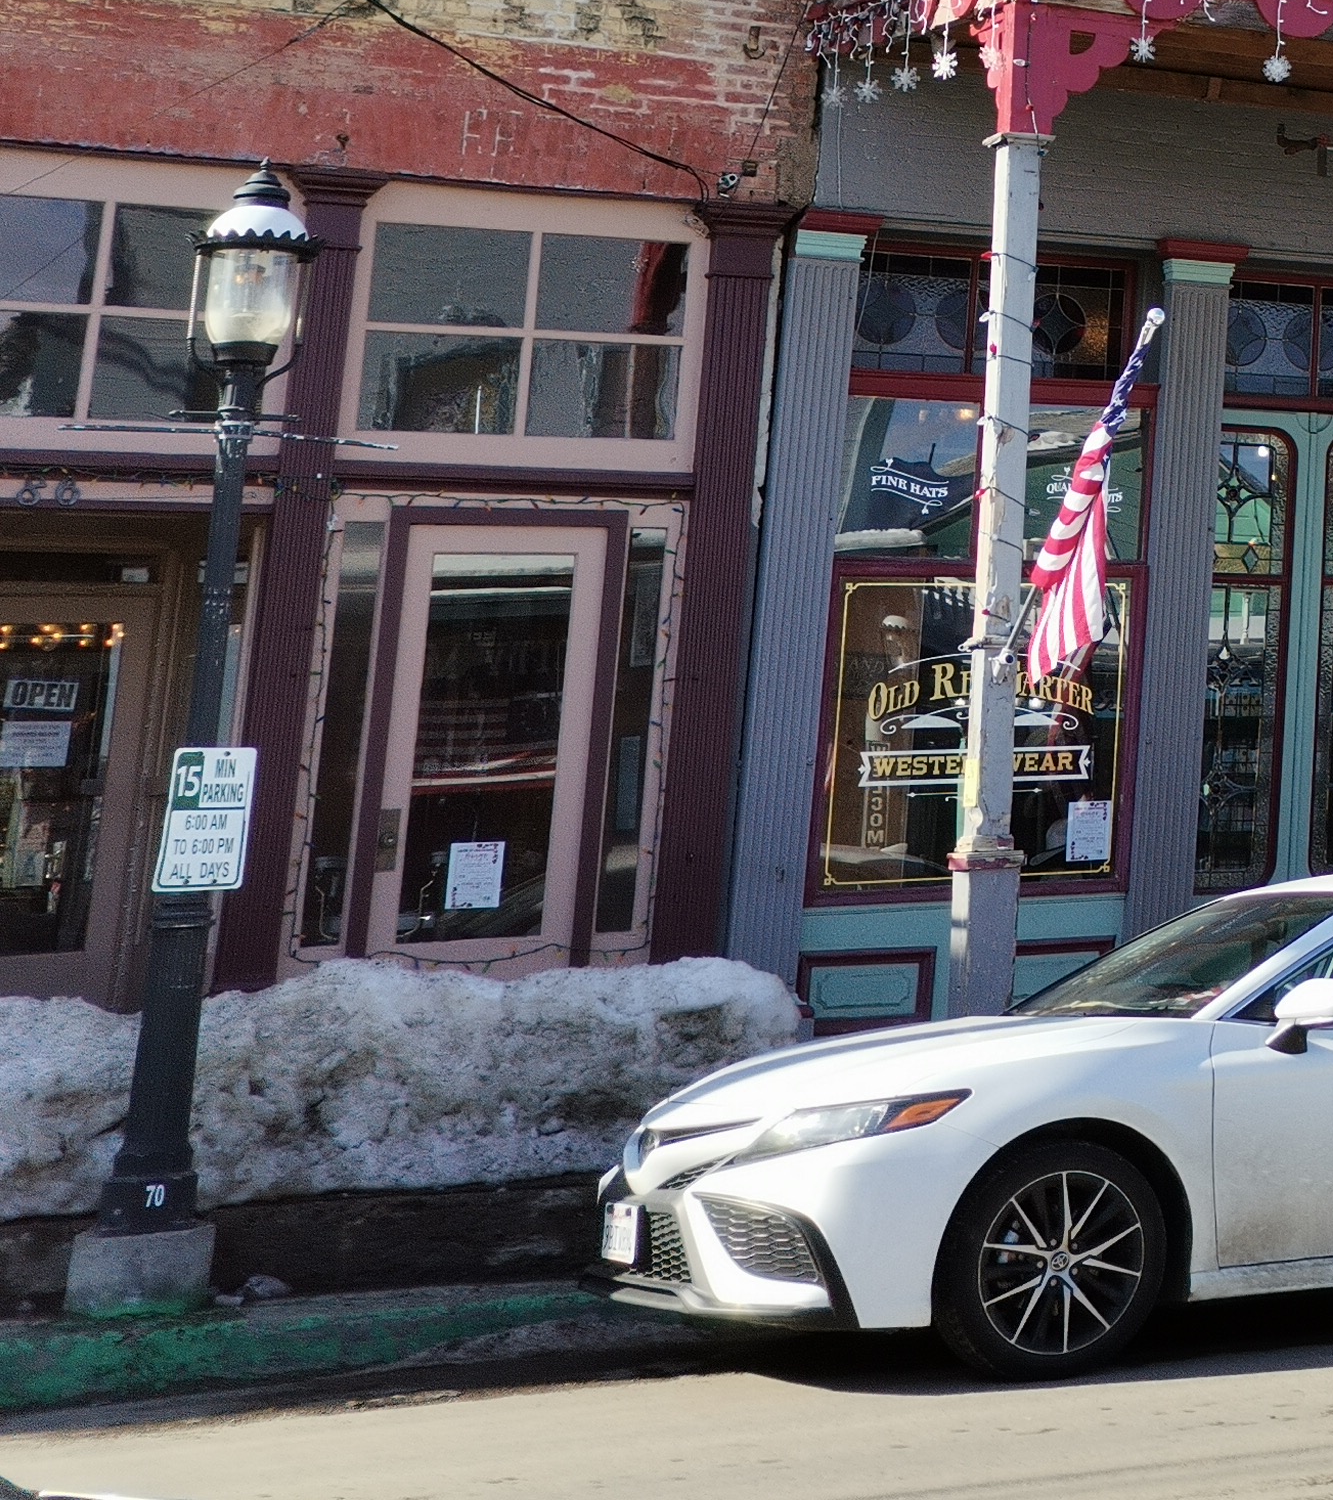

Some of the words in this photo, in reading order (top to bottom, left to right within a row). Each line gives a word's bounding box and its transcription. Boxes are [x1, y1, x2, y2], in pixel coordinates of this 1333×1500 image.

[871, 474, 907, 491] FINE
[909, 482, 949, 499] HATS
[11, 682, 75, 707] OPEN
[868, 680, 920, 721] OLD
[176, 765, 202, 797] 15
[214, 759, 236, 778] MIN
[201, 784, 244, 803] PARKING
[185, 815, 207, 831] 6:00
[210, 814, 228, 830] AM
[173, 839, 187, 855] TO
[192, 839, 214, 855] 6:00
[217, 838, 234, 854] PM
[169, 864, 192, 879] ALL
[200, 862, 229, 879] DAYS
[145, 1184, 165, 1208] 70
